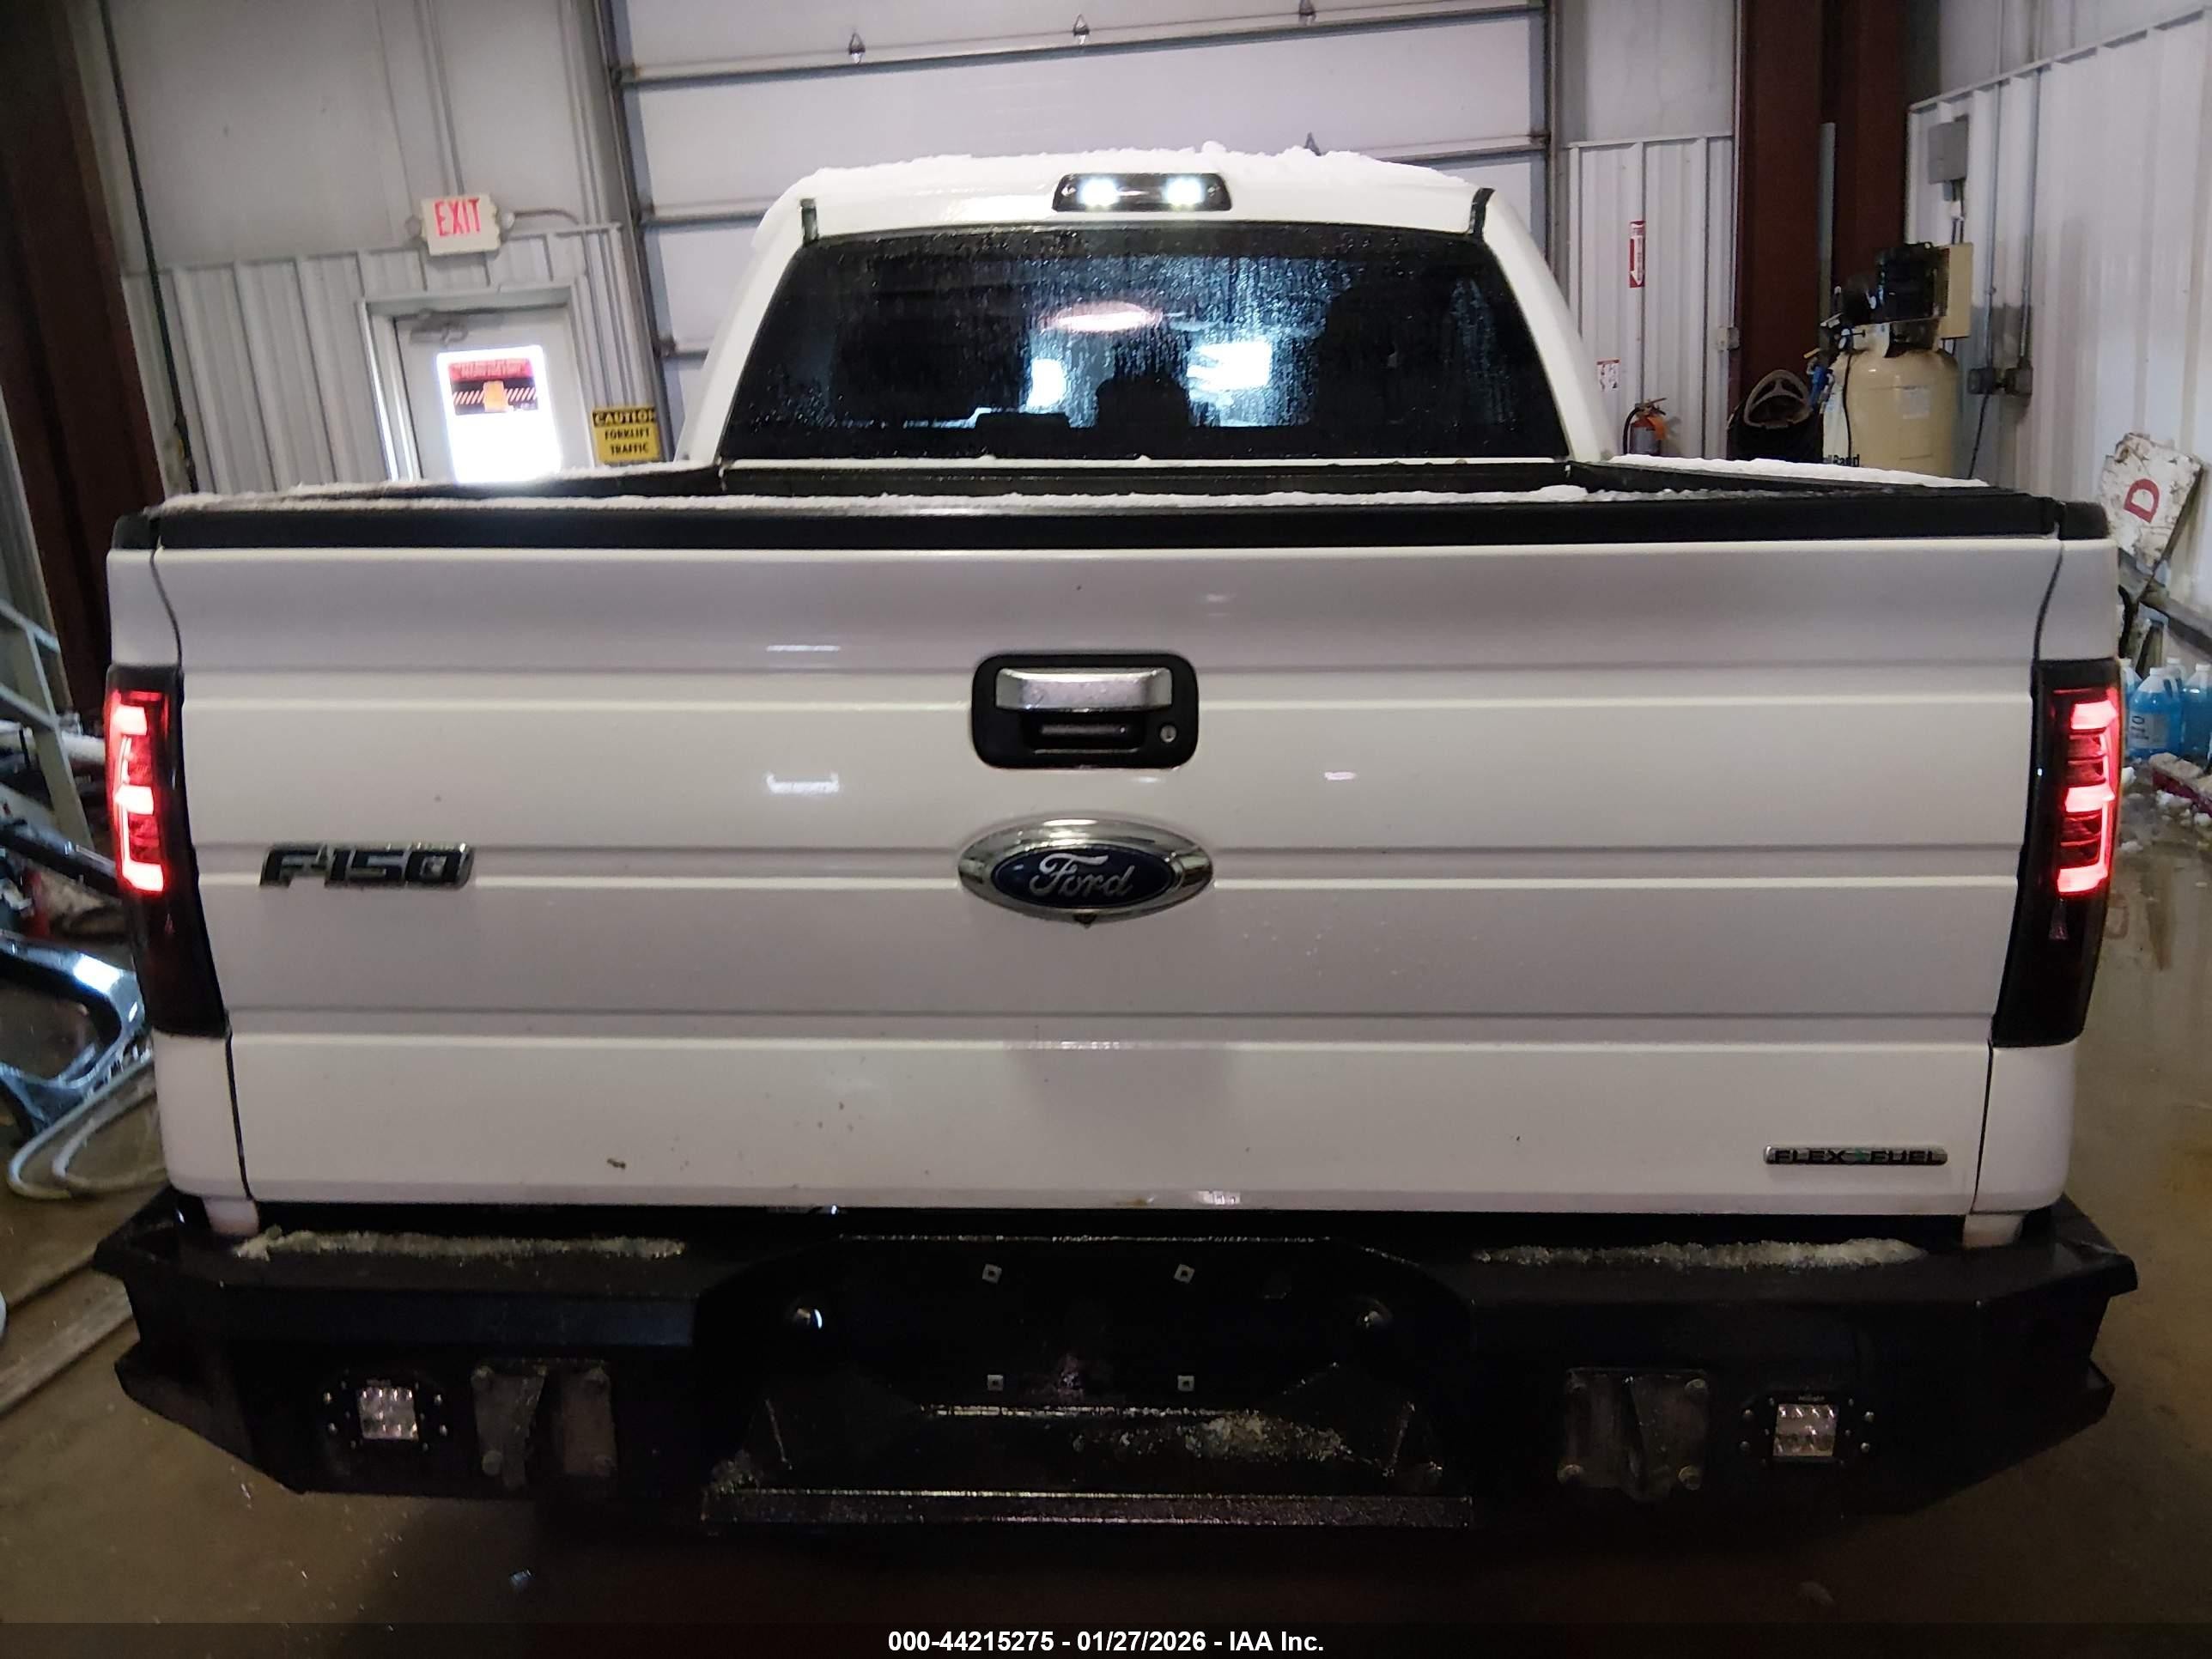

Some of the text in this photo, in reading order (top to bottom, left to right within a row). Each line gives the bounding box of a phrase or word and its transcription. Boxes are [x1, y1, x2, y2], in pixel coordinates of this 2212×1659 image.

[434, 198, 480, 236] EXIT
[605, 428, 650, 440] FORKLIFT
[611, 442, 647, 455] TRAFFIC
[2124, 478, 2160, 523] D
[1030, 852, 1135, 898] Ford
[1774, 1149, 1942, 1164] FLEX FUEL
